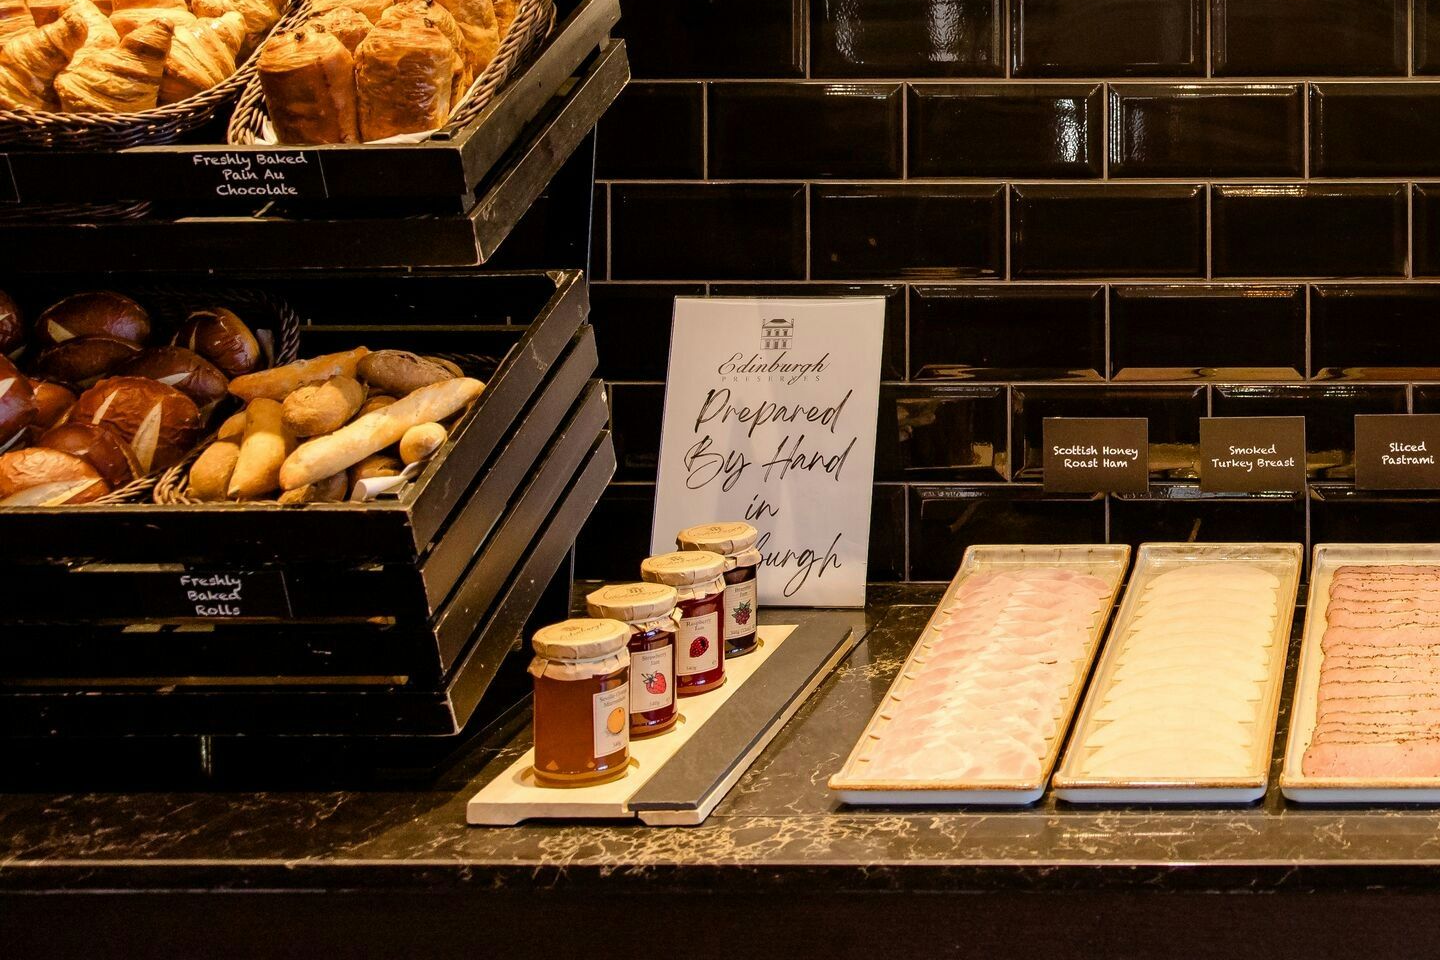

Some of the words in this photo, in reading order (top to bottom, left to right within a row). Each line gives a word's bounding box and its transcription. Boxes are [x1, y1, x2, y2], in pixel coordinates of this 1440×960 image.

[193, 152, 250, 170] Freshly
[256, 152, 308, 165] Baked
[222, 169, 258, 181] Pain
[264, 169, 285, 180] Au
[216, 184, 298, 196] Chocolate
[718, 351, 831, 385] Edinburgh
[694, 388, 853, 438] Prepared
[1053, 445, 1098, 456] Scottish
[1102, 445, 1139, 460] Honey
[1228, 444, 1277, 455] Smoked
[1389, 441, 1427, 453] Sliced
[683, 435, 752, 493] By
[761, 434, 858, 482] Hand
[1063, 458, 1099, 468] Roast
[1103, 458, 1128, 468] Ham
[1211, 458, 1253, 472] Turkey
[1257, 457, 1295, 467] Breast
[1381, 455, 1435, 465] Pastrami
[744, 493, 780, 521] in
[756, 532, 842, 598] burgh
[180, 574, 241, 593] Freshly
[187, 589, 242, 601] Baked
[195, 604, 241, 616] Rolls
